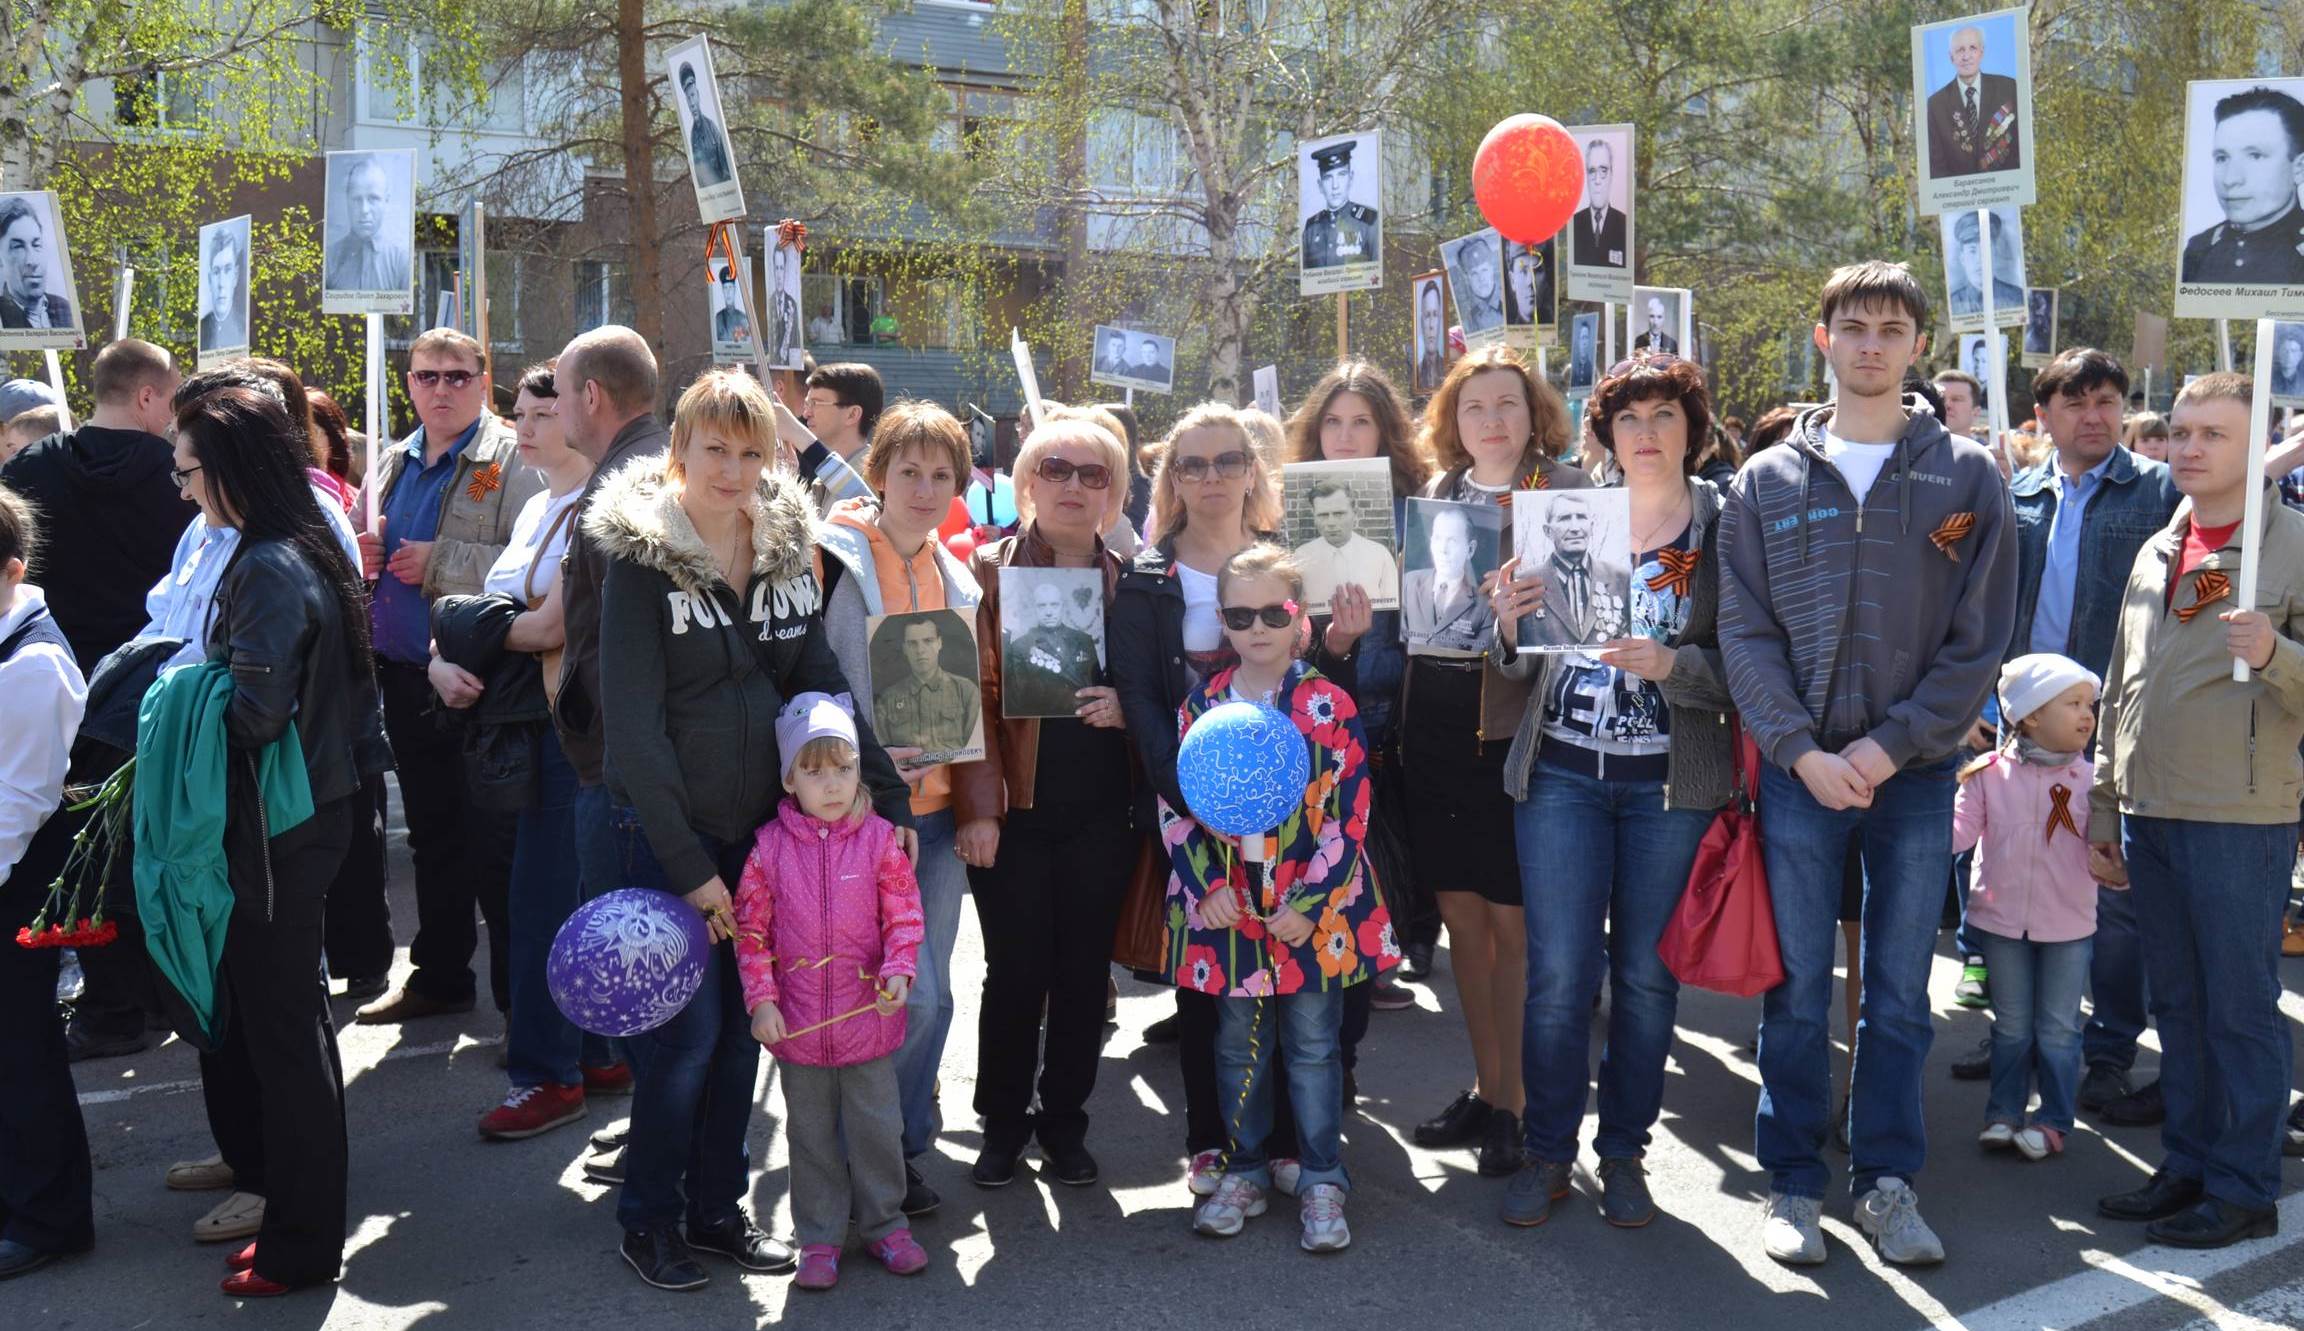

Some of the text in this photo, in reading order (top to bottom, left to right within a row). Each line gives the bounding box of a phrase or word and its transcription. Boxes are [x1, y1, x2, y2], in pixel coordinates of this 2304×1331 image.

[1932, 189, 1970, 200] Александр
[2179, 286, 2232, 297] Федосеев
[2235, 286, 2278, 298] Михаил
[1890, 470, 1952, 487] CNVERT
